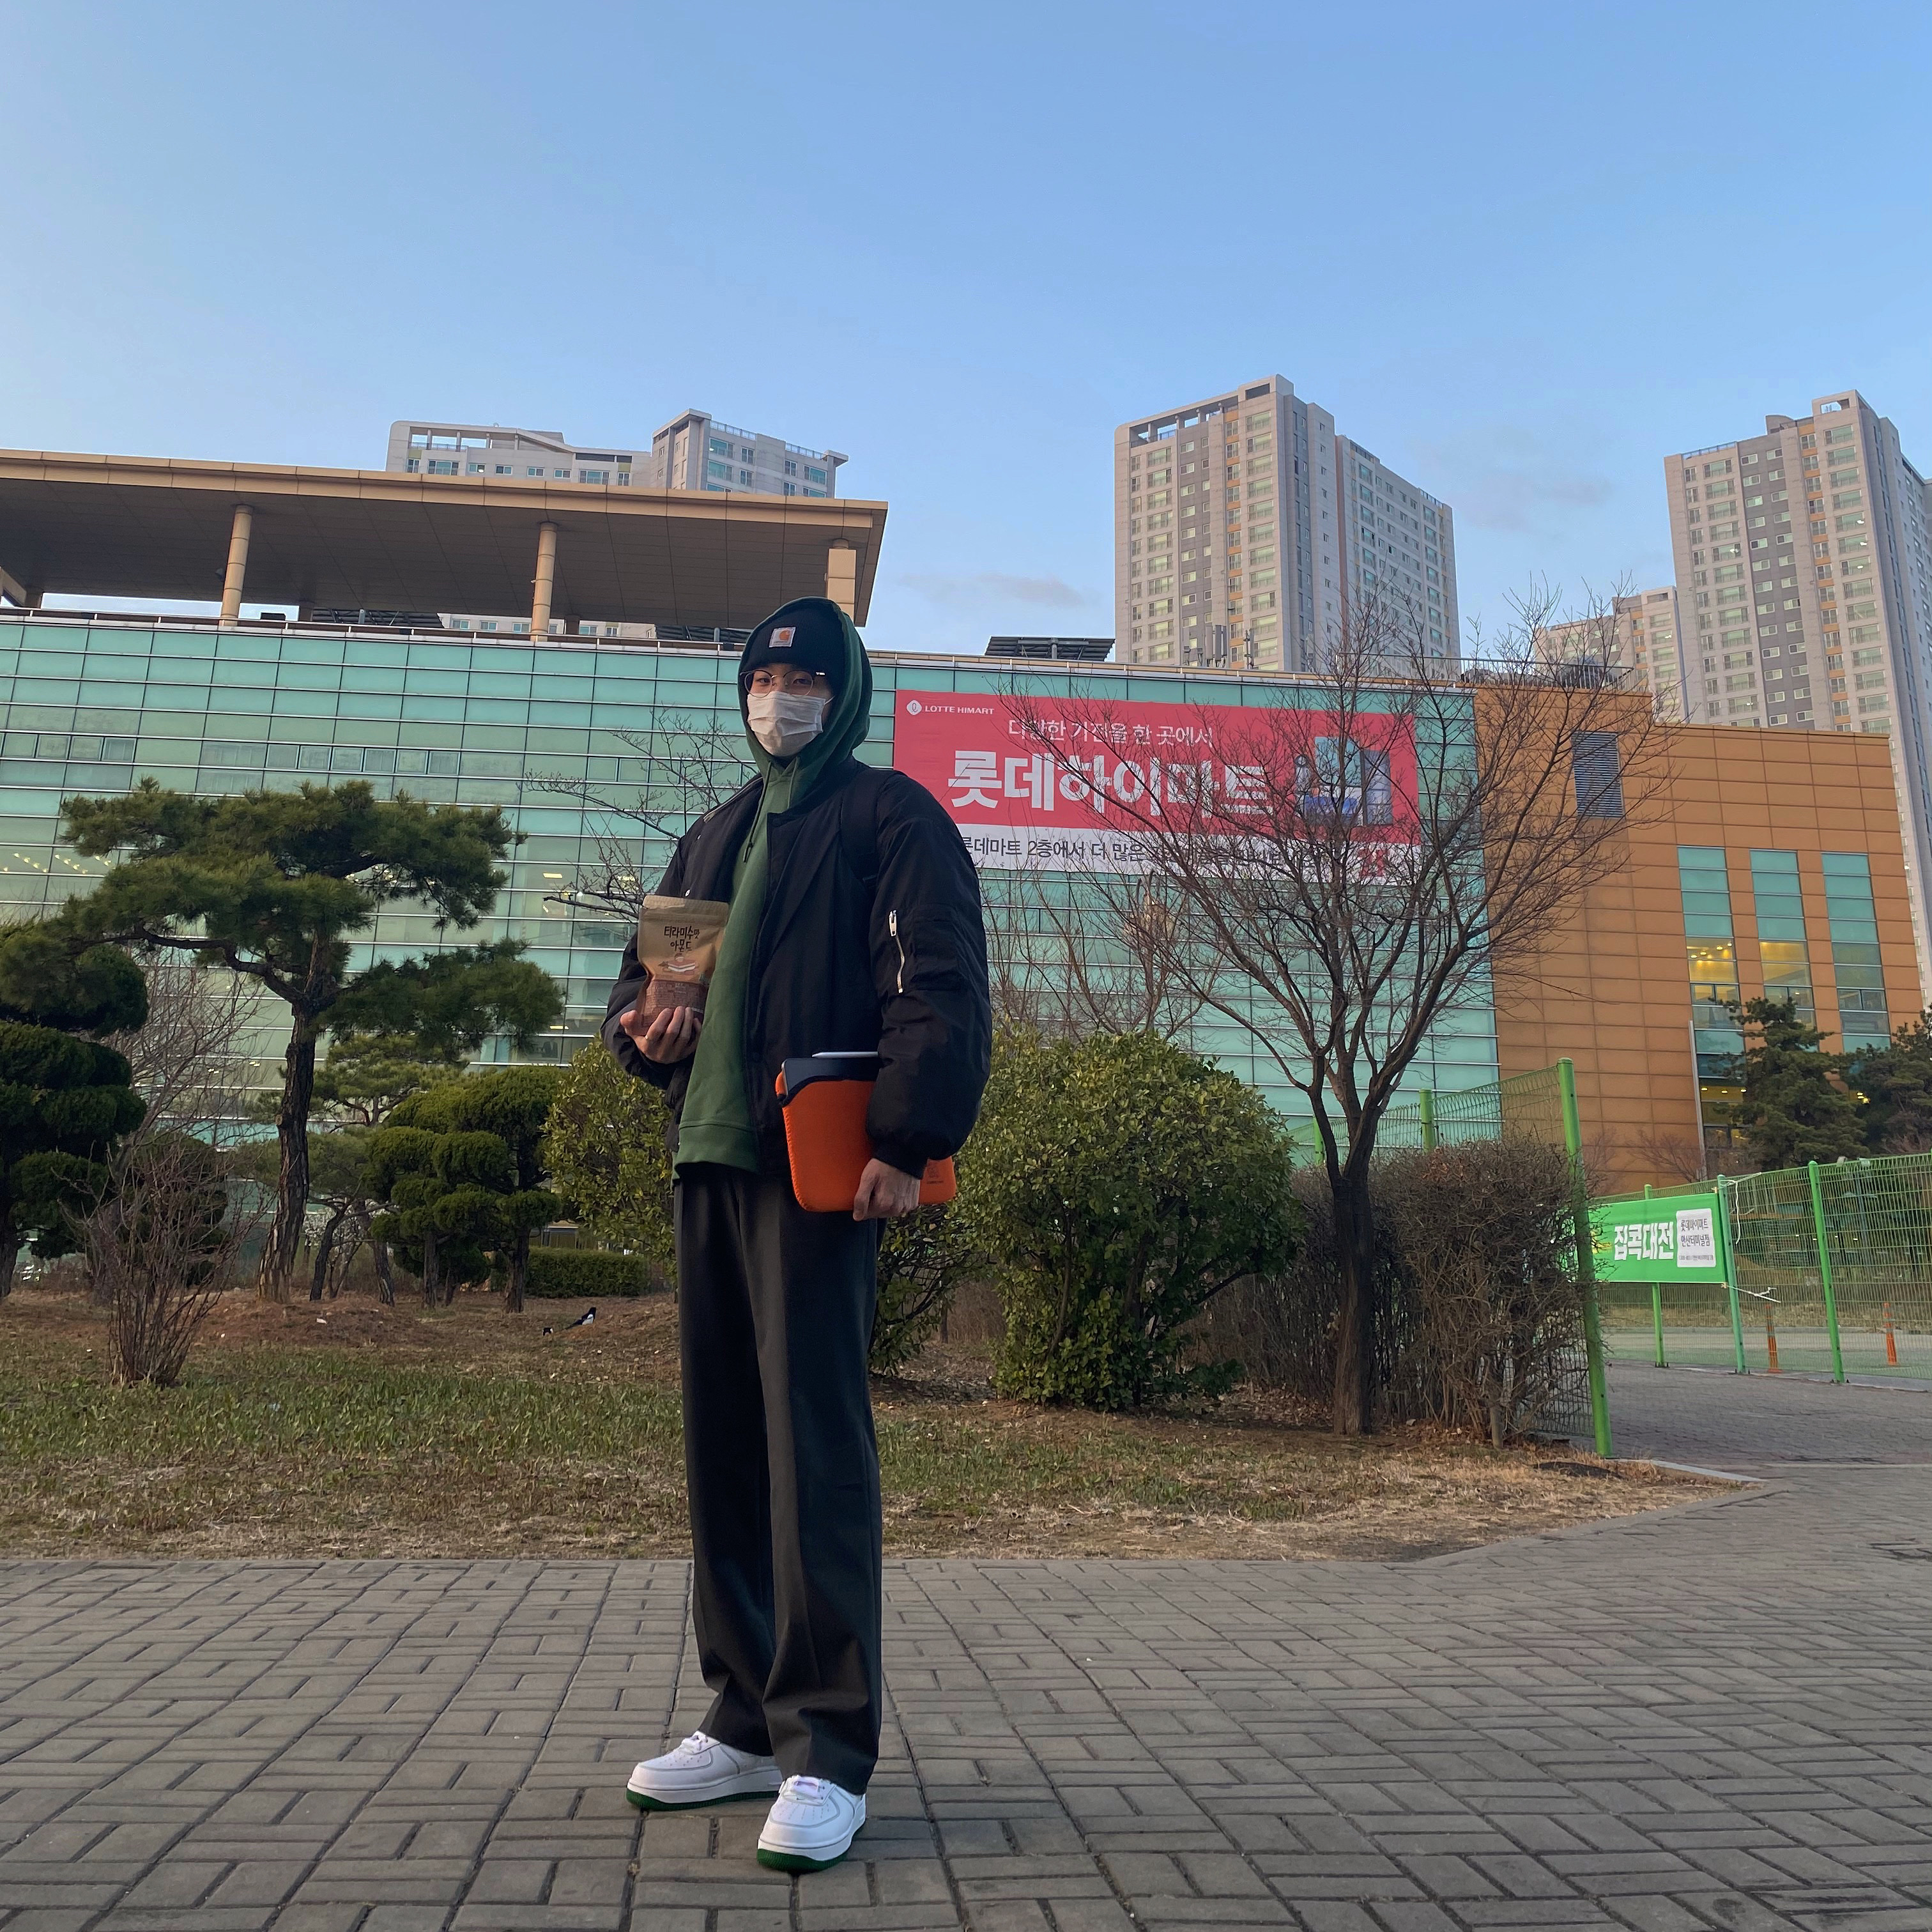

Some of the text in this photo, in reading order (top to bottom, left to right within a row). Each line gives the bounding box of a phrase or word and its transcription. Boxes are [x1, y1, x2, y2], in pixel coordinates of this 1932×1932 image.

[924, 705, 995, 715] LOTTE HIMART
[1156, 725, 1213, 748] 곳에서
[948, 750, 1274, 818] 롯데하이마트
[1027, 838, 1084, 860] 2층에서
[1091, 842, 1106, 860] 더
[1112, 843, 1149, 862] 많은
[664, 925, 700, 940] 티라미수맛
[670, 939, 693, 953] 아몬드
[1614, 1222, 1674, 1261] 집콕대전
